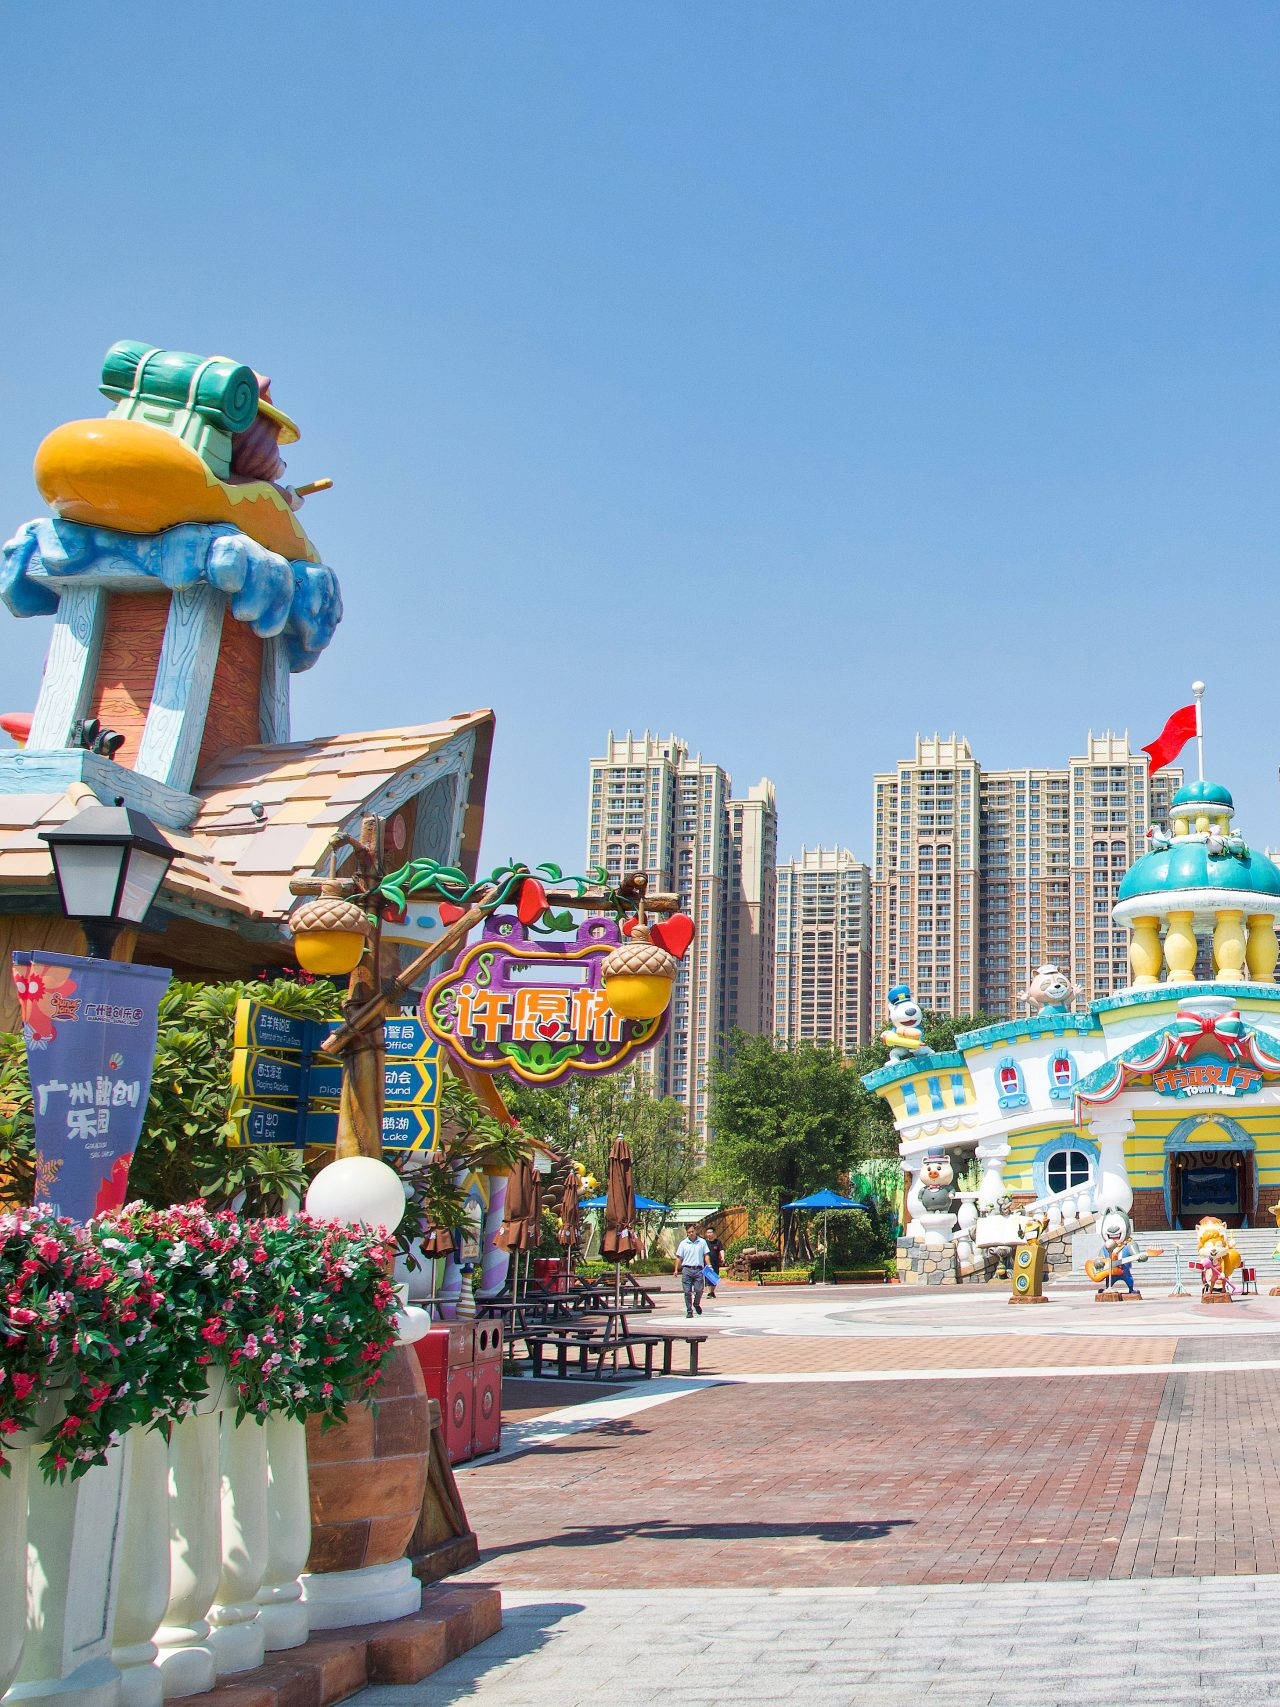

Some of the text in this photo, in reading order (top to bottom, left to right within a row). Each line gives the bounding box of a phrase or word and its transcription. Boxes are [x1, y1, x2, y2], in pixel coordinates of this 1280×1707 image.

[456, 984, 623, 1042] 许愿桥
[385, 1041, 413, 1050] Office
[1153, 1066, 1264, 1091] 市政厅
[37, 1076, 140, 1116] 广州融创
[1183, 1085, 1236, 1096] Town Hall
[265, 1113, 279, 1125] 出口
[264, 1129, 275, 1138] Exit
[383, 1133, 408, 1141] Lake
